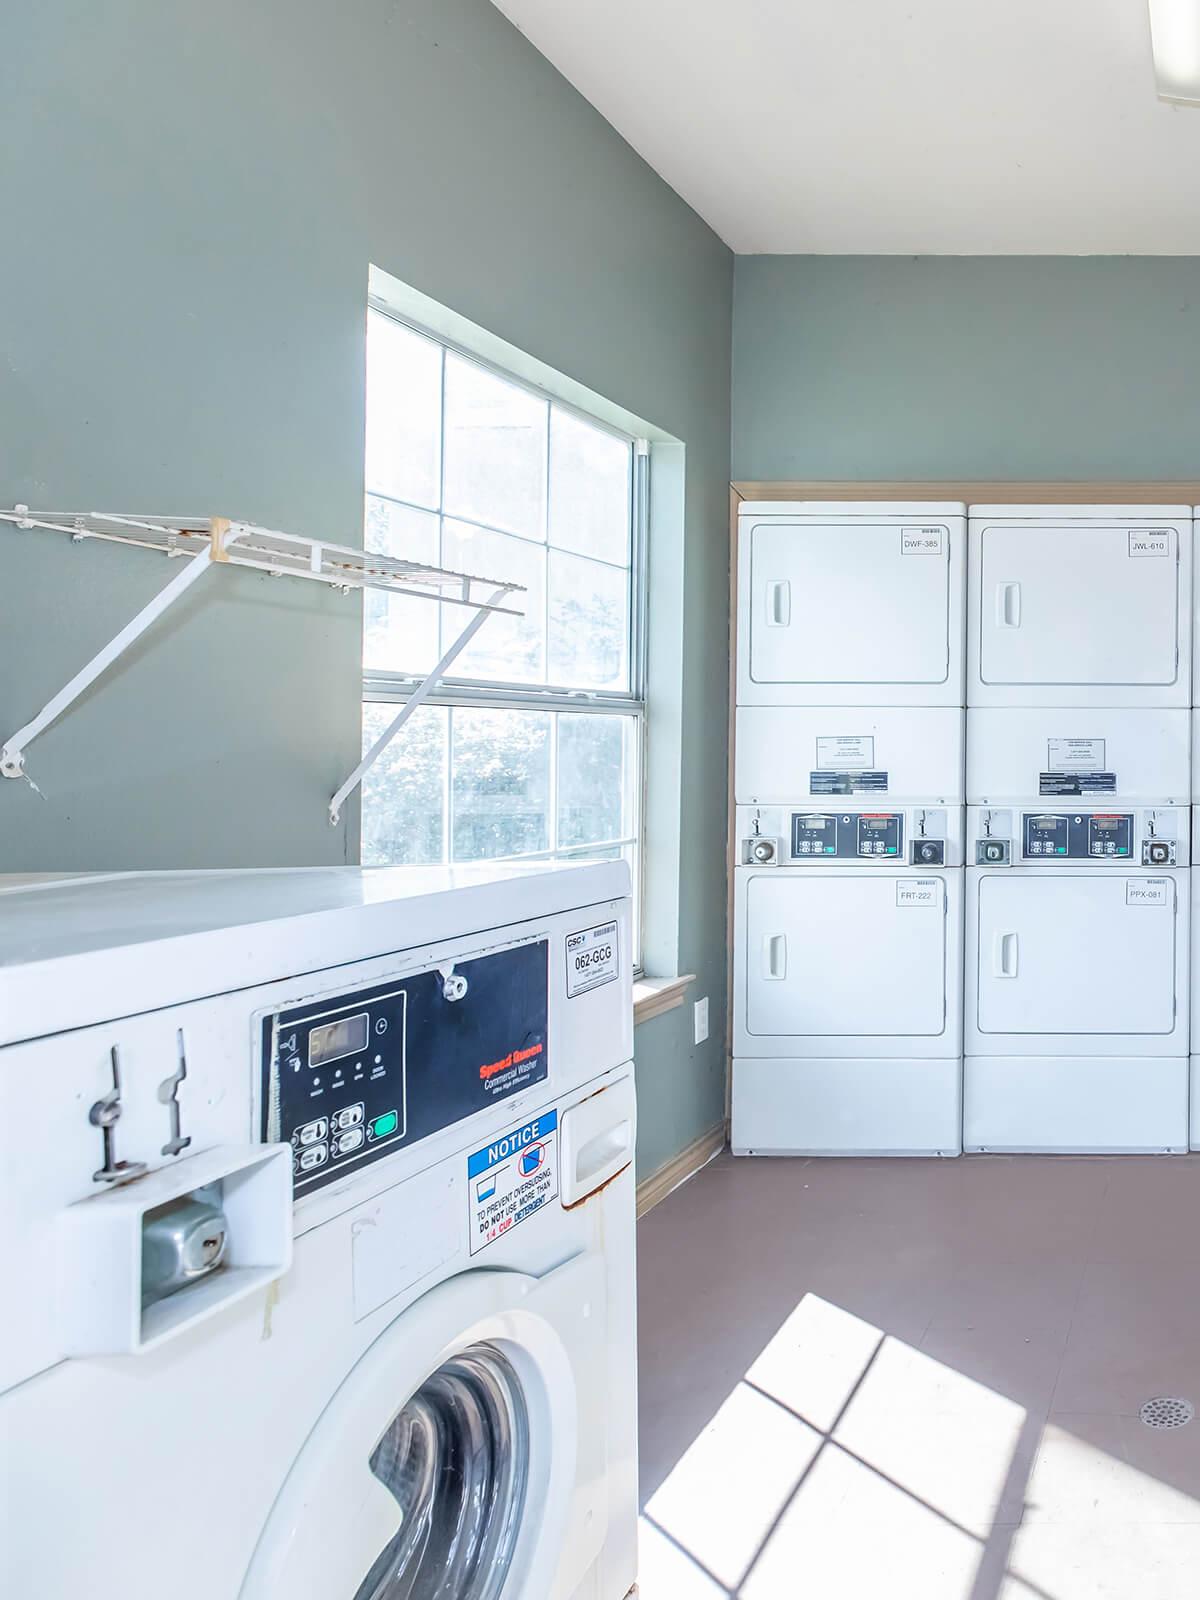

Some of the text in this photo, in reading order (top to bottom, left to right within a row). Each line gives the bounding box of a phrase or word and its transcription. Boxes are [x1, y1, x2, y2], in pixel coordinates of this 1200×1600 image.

[904, 540, 938, 548] DWF-385
[901, 892, 932, 900] FRT-222
[568, 936, 582, 947] CSC
[575, 946, 612, 970] 062-GCG
[480, 1044, 543, 1079] Speed Queen
[485, 1059, 538, 1090] Commercial Washer
[488, 1122, 540, 1164] NOTICE
[478, 1210, 486, 1222] TO
[487, 1191, 513, 1218] PREVENT
[480, 1180, 551, 1234] DO NOT USE MORE THAN
[498, 1218, 513, 1233] CUP
[514, 1194, 546, 1222] DETERGENT
